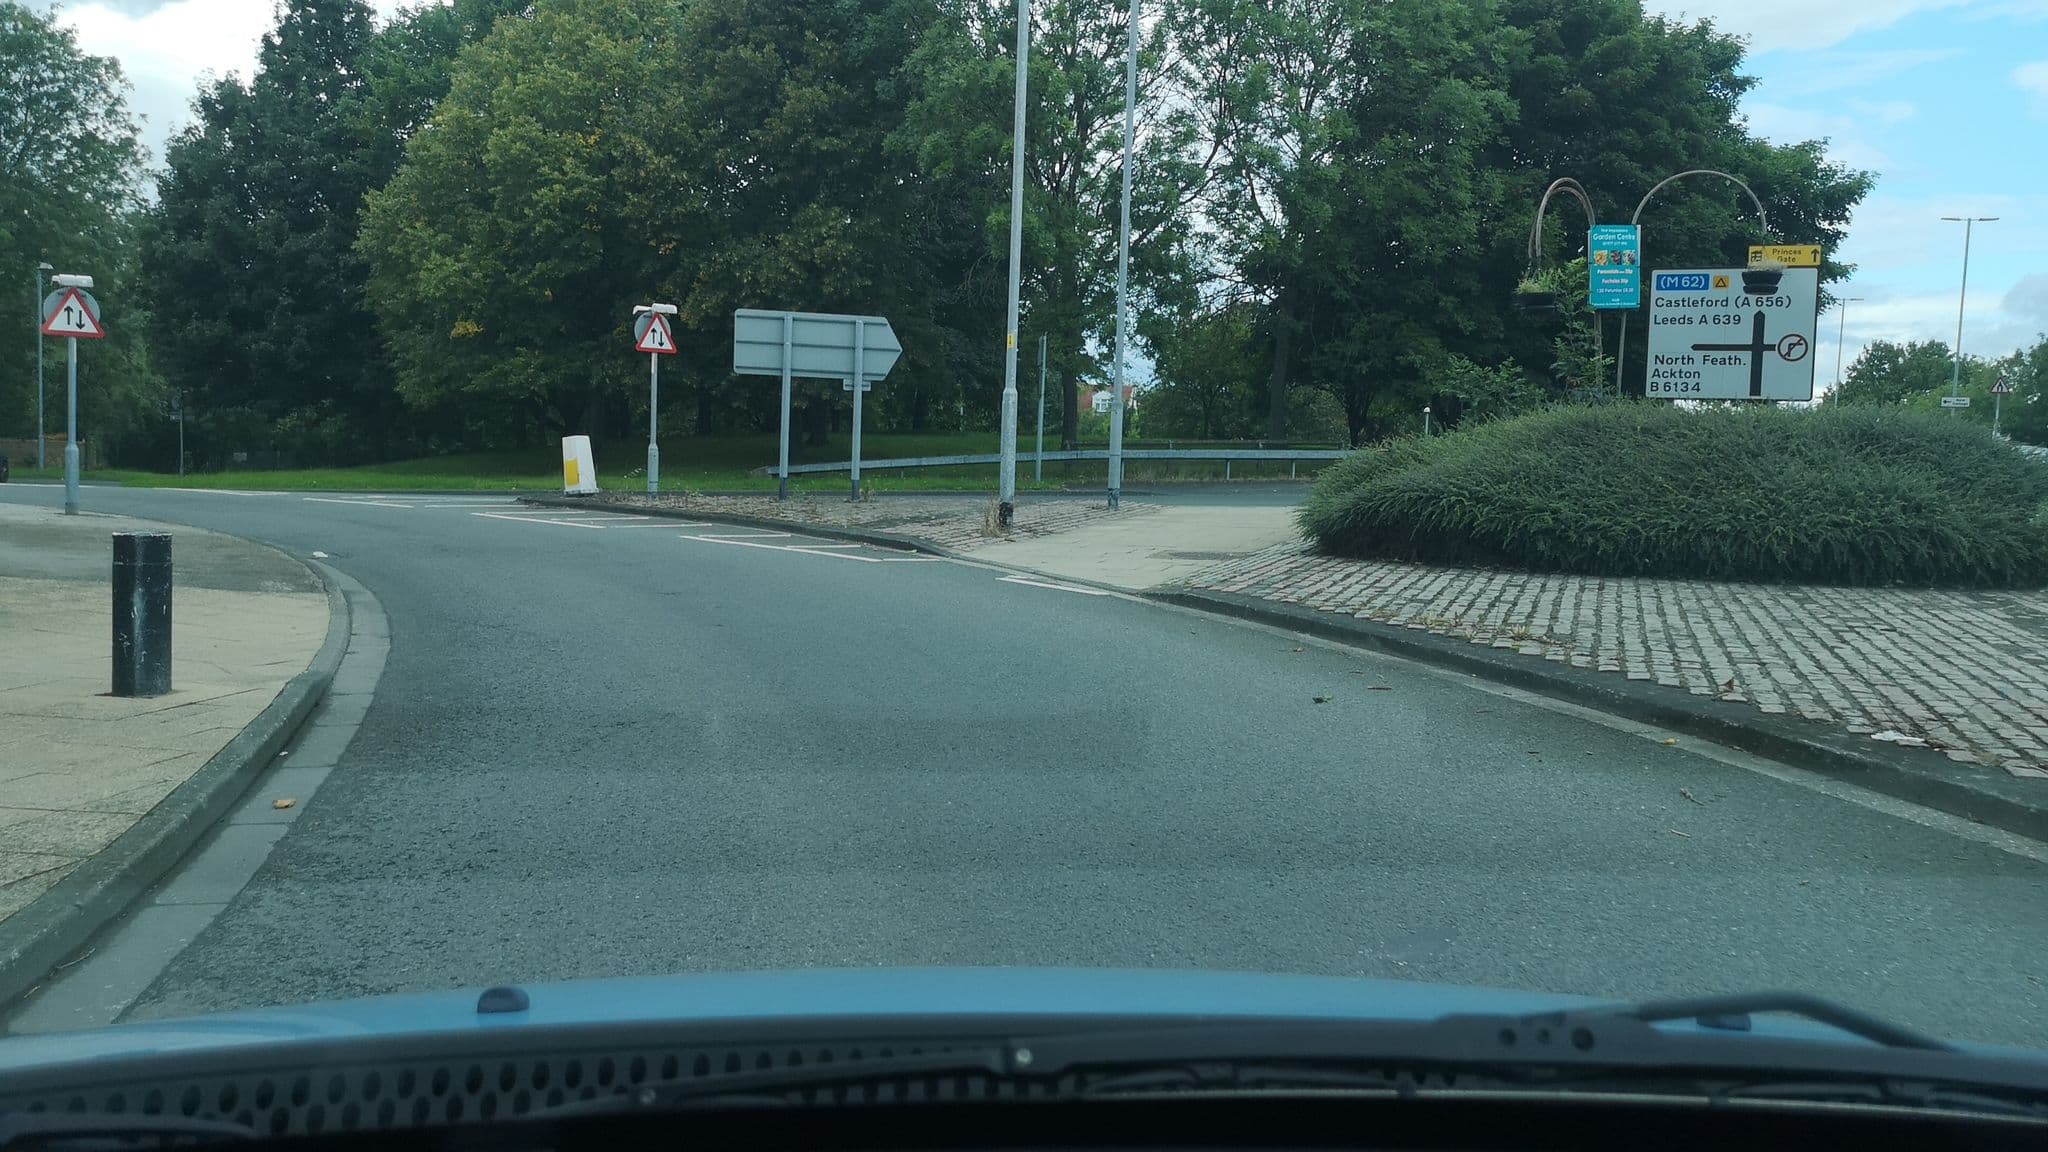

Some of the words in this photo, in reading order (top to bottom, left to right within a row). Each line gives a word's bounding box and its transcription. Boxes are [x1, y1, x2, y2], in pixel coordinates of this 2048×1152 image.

[1655, 297, 1729, 308] Castleford
[1755, 296, 1792, 309] 656)
[1654, 314, 1694, 325] Leeds
[1698, 314, 1709, 325] A
[1712, 314, 1741, 325] 639
[1654, 355, 1695, 366] North
[1702, 355, 1747, 366] Feath.
[1651, 368, 1701, 379] Ackton
[1650, 381, 1659, 392] B
[1663, 382, 1701, 393] 6134
